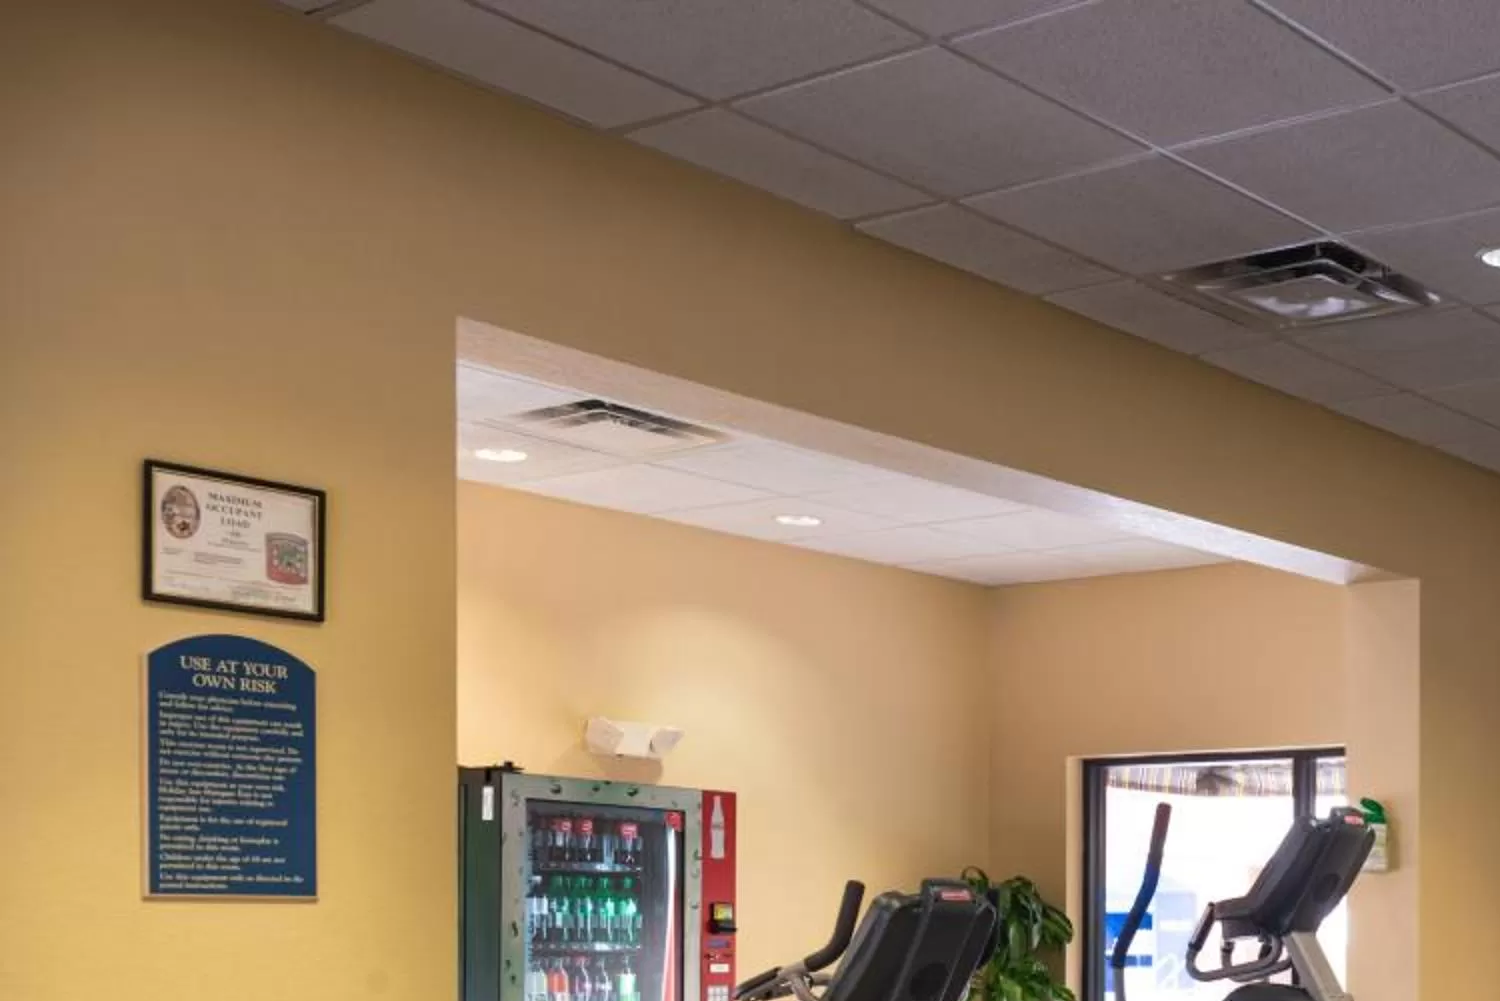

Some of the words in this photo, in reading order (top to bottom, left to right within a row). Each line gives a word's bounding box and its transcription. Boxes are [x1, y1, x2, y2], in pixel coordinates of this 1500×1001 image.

[179, 655, 211, 672] USE
[216, 659, 240, 675] AT
[243, 661, 289, 680] YOUR
[192, 673, 236, 689] OWN
[240, 677, 277, 694] RISK
